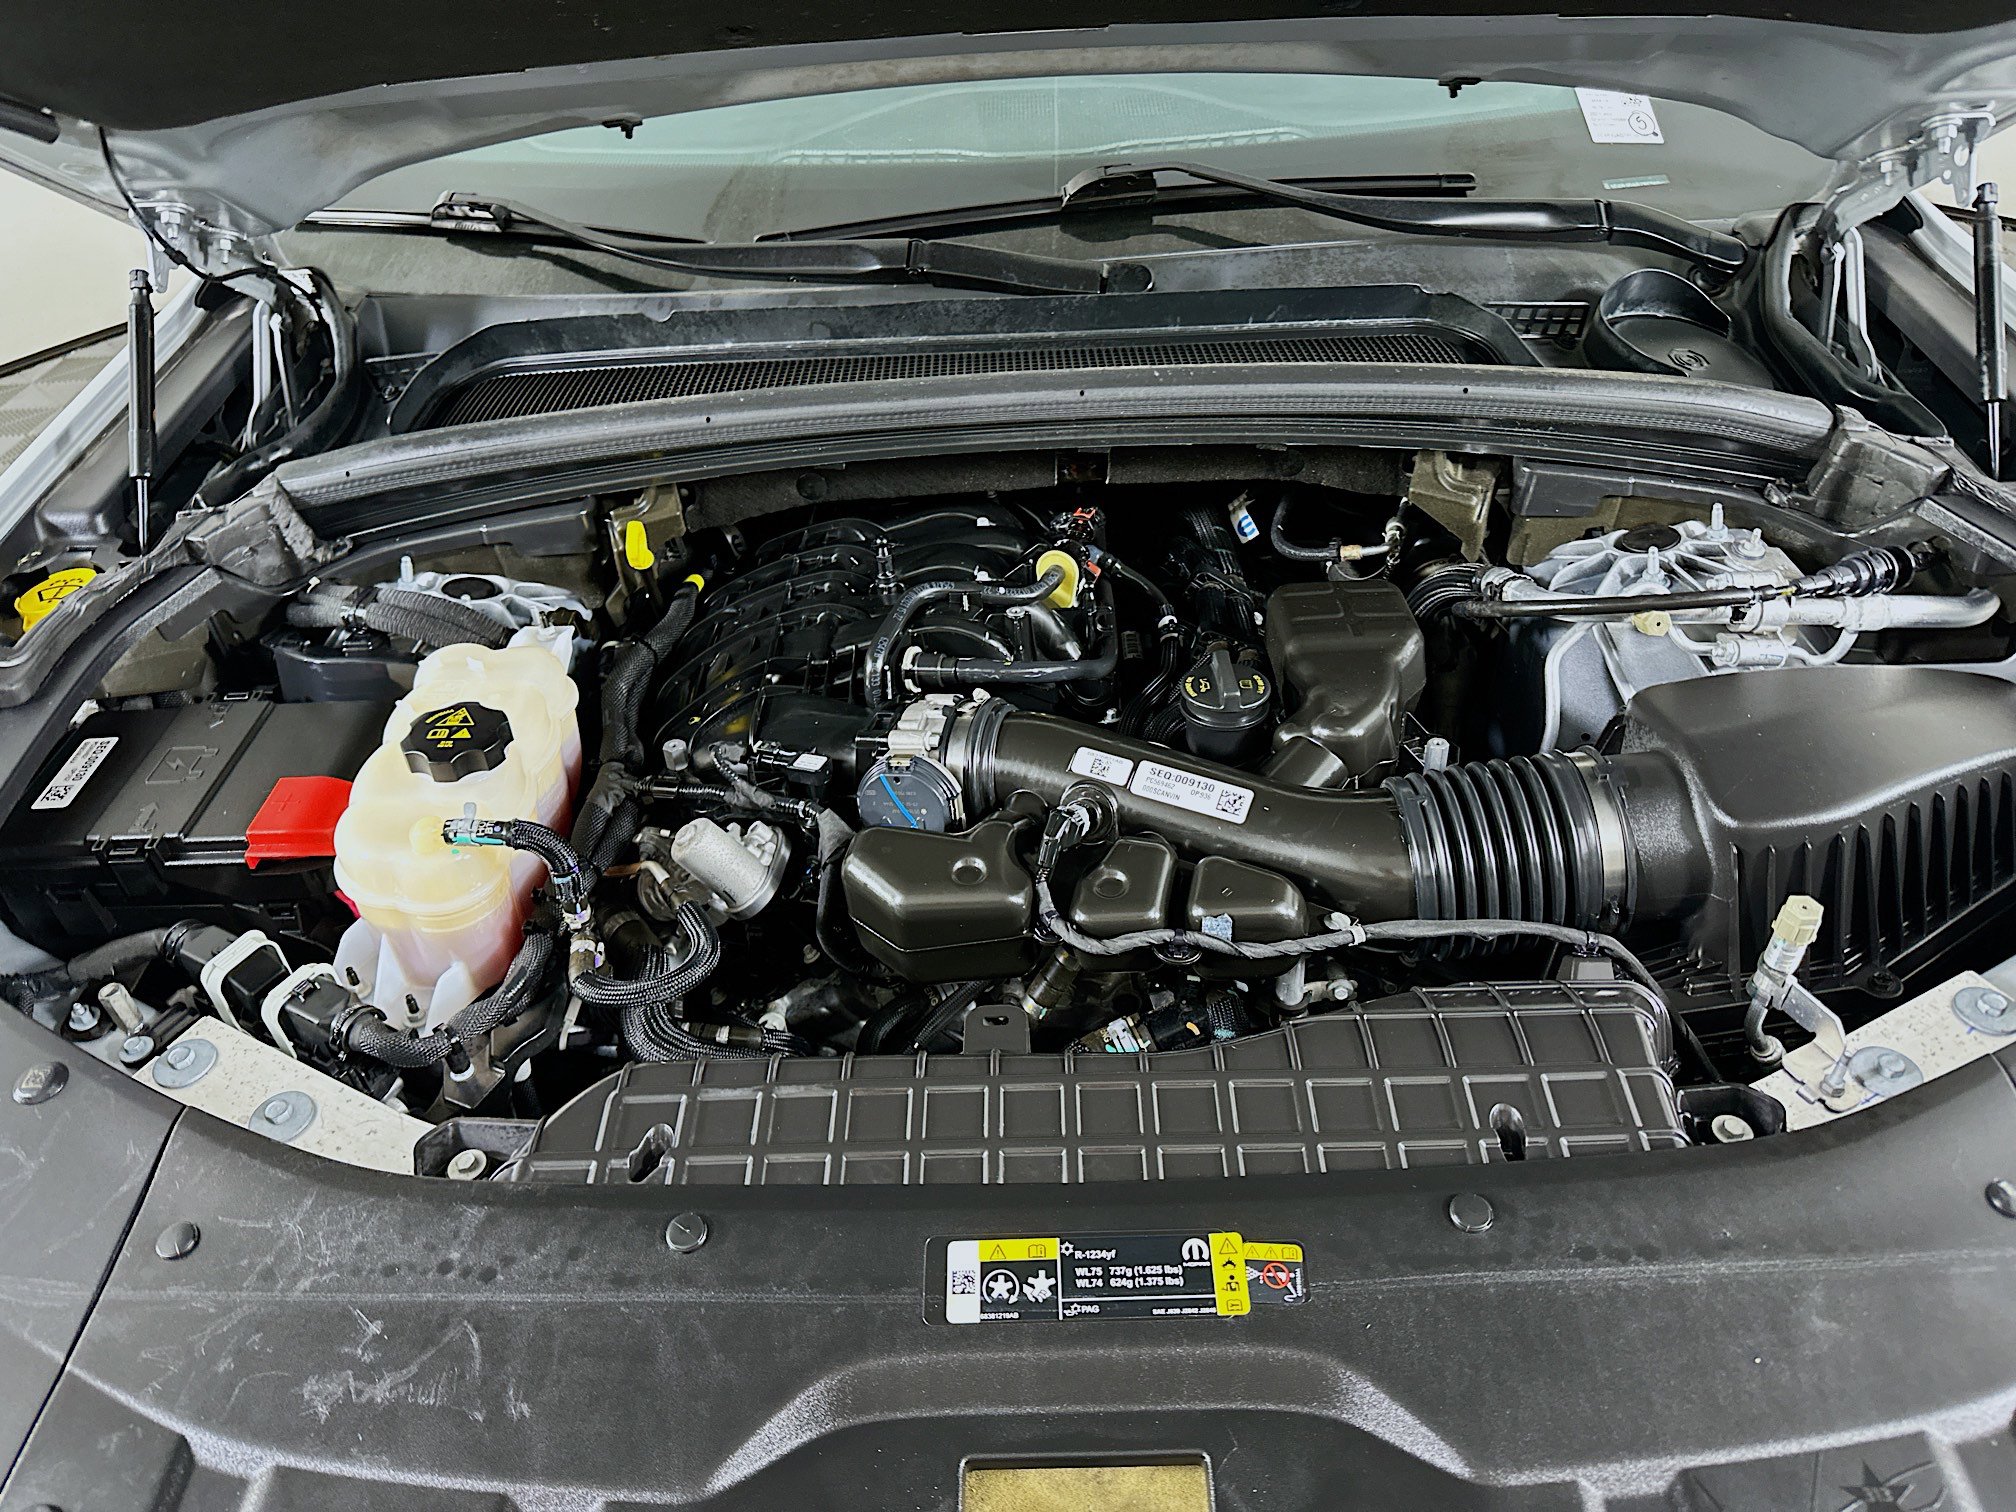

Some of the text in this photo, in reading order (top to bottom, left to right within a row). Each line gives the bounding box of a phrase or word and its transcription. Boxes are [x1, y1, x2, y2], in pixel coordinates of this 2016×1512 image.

[1149, 767, 1216, 793] SEQ:009130
[1074, 1249, 1117, 1261] R-1234yf
[1075, 1264, 1183, 1277] WL75 737g (1.625 lbs)
[1075, 1276, 1185, 1289] WL74 624g (1.375 lbs)
[1081, 1304, 1100, 1314] PAG
